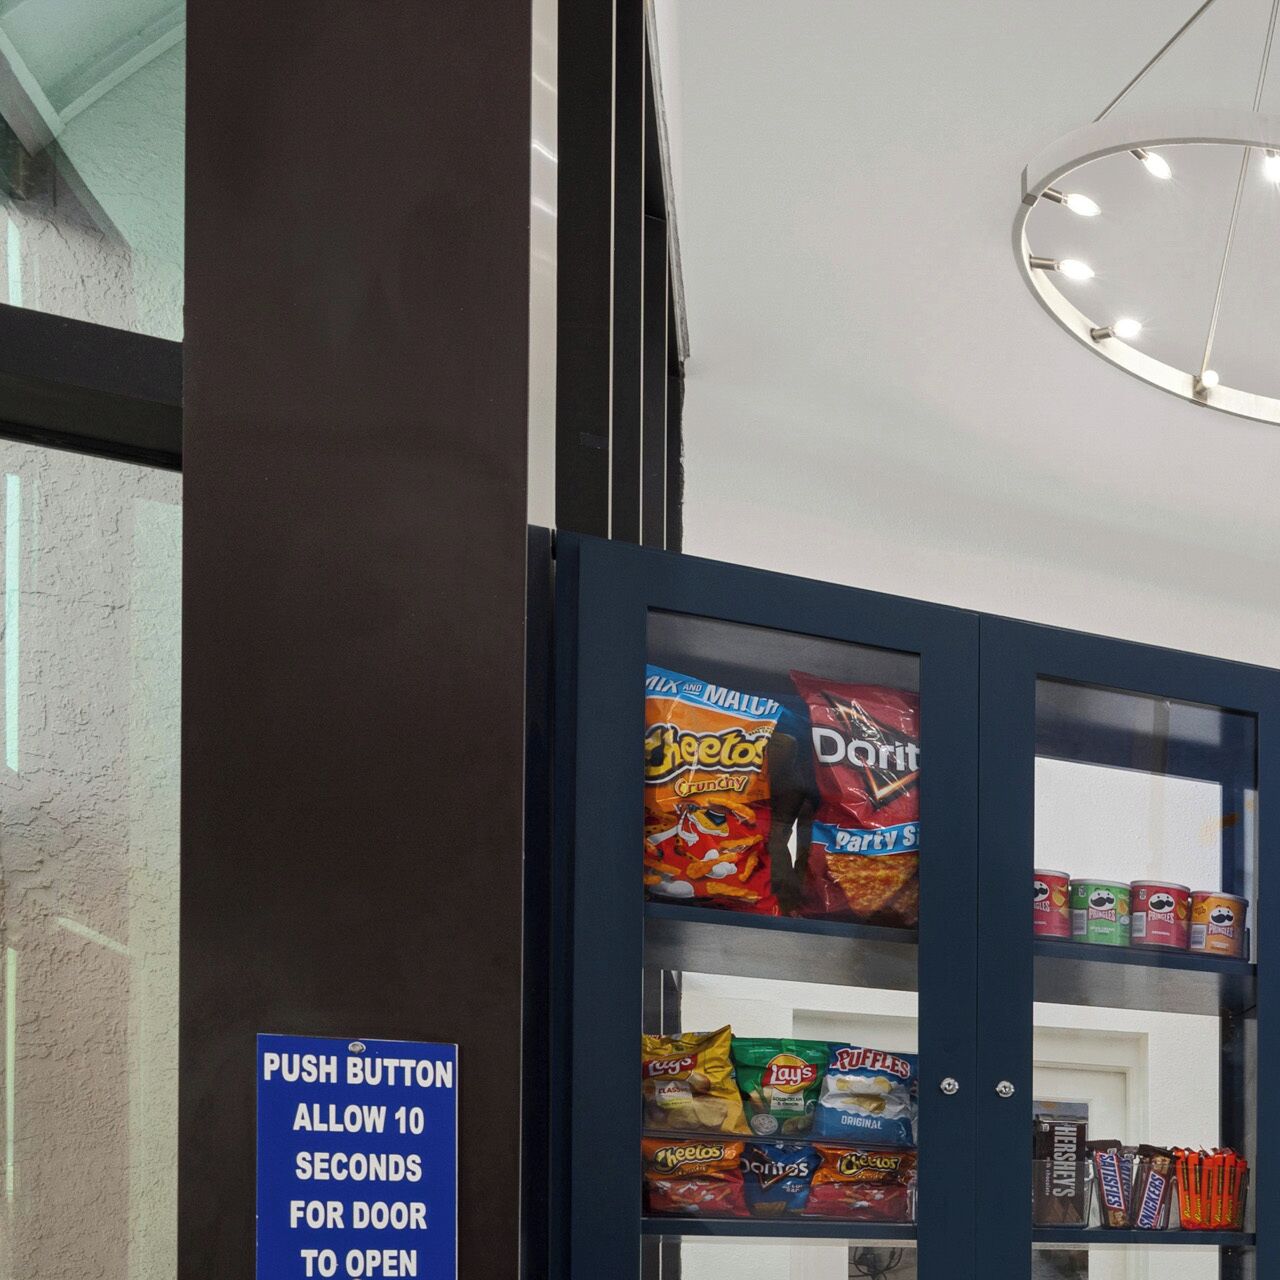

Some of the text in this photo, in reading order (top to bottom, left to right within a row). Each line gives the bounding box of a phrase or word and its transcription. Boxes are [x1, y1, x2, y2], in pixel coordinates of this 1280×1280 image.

[683, 684, 702, 692] AND
[703, 684, 780, 715] MATCH
[811, 727, 920, 771] Dorit
[675, 774, 748, 797] Crunchy
[835, 830, 898, 852] Party
[1089, 907, 1116, 922] PRINGLES
[1148, 911, 1175, 924] PRINGLES
[263, 1052, 453, 1088] PUSH BUTTON
[770, 1064, 813, 1086] Lay's
[830, 1048, 910, 1079] RUFFLES
[293, 1103, 424, 1135] ALLOW 10
[841, 1115, 882, 1130] ORIGINAL
[295, 1151, 422, 1183] SECONDS
[655, 1145, 722, 1173] Cheetos
[840, 1153, 898, 1175] Cheetos
[1052, 1126, 1077, 1197] HERSHEY'S
[1100, 1154, 1123, 1208] SATISFIES
[290, 1200, 427, 1230] FOR DOOR
[1139, 1172, 1164, 1229] SNICKERS
[300, 1249, 417, 1278] TO OPEN
